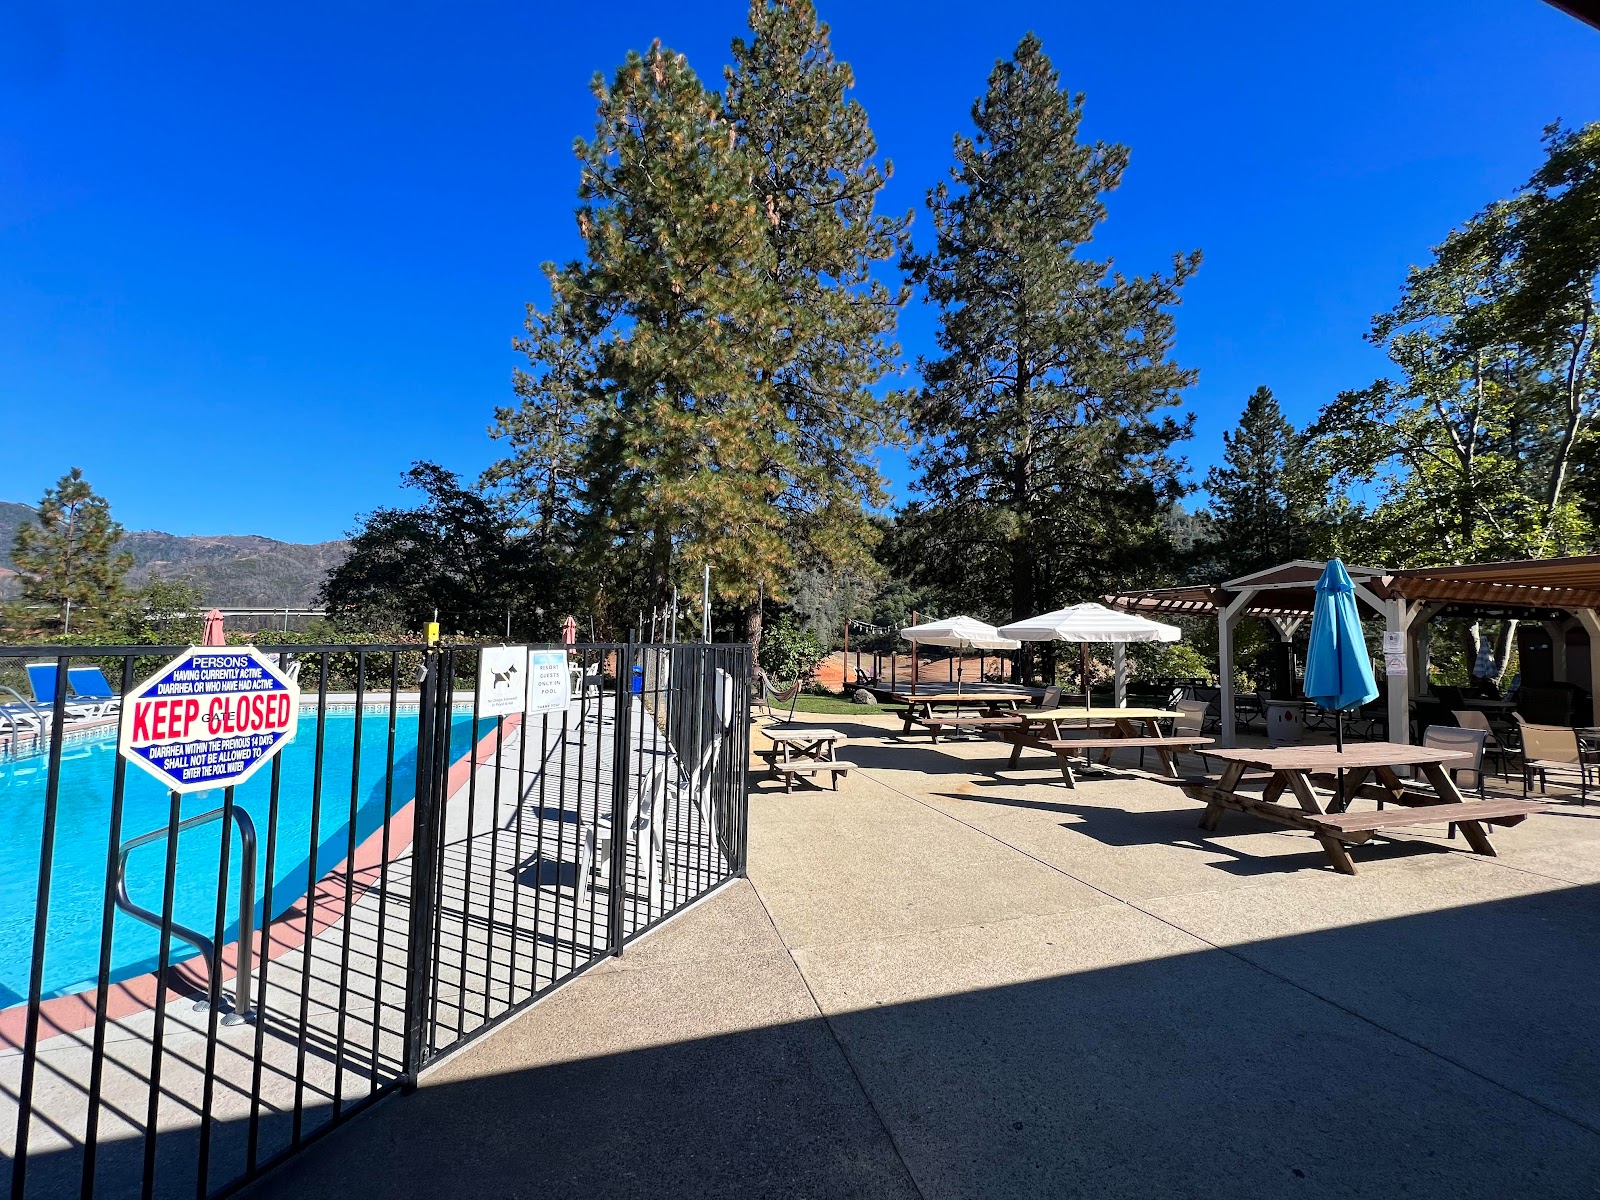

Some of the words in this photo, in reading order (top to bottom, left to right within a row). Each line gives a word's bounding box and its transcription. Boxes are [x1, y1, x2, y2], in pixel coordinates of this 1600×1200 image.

[192, 657, 248, 668] PERSONS
[174, 670, 200, 681] HAVING
[201, 668, 238, 679] CURRENTLY
[240, 668, 262, 678] ACTIVE
[158, 682, 193, 694] DIARRHEA
[194, 682, 204, 692] OR
[206, 682, 220, 691] WHO
[222, 681, 238, 691] HAVE
[238, 680, 252, 690] HAD
[252, 679, 273, 689] ACTIVE
[133, 699, 199, 742] KEEP
[208, 694, 290, 735] CLOSED
[202, 712, 235, 722] GATE
[149, 745, 183, 759] DIARRHEA
[185, 743, 208, 754] WITHIN
[209, 741, 220, 752] THE
[222, 738, 250, 750] PREVIOUS
[251, 737, 258, 746] 14
[259, 735, 273, 745] DAYS
[164, 757, 189, 770] SHALL
[190, 754, 206, 766] NOT
[208, 753, 217, 763] BE
[218, 749, 251, 762] ALLOWED
[252, 748, 262, 758] TO
[183, 768, 201, 779] ENTER
[202, 766, 212, 776] THE
[212, 764, 226, 775] POOL
[228, 761, 244, 773] WATER
